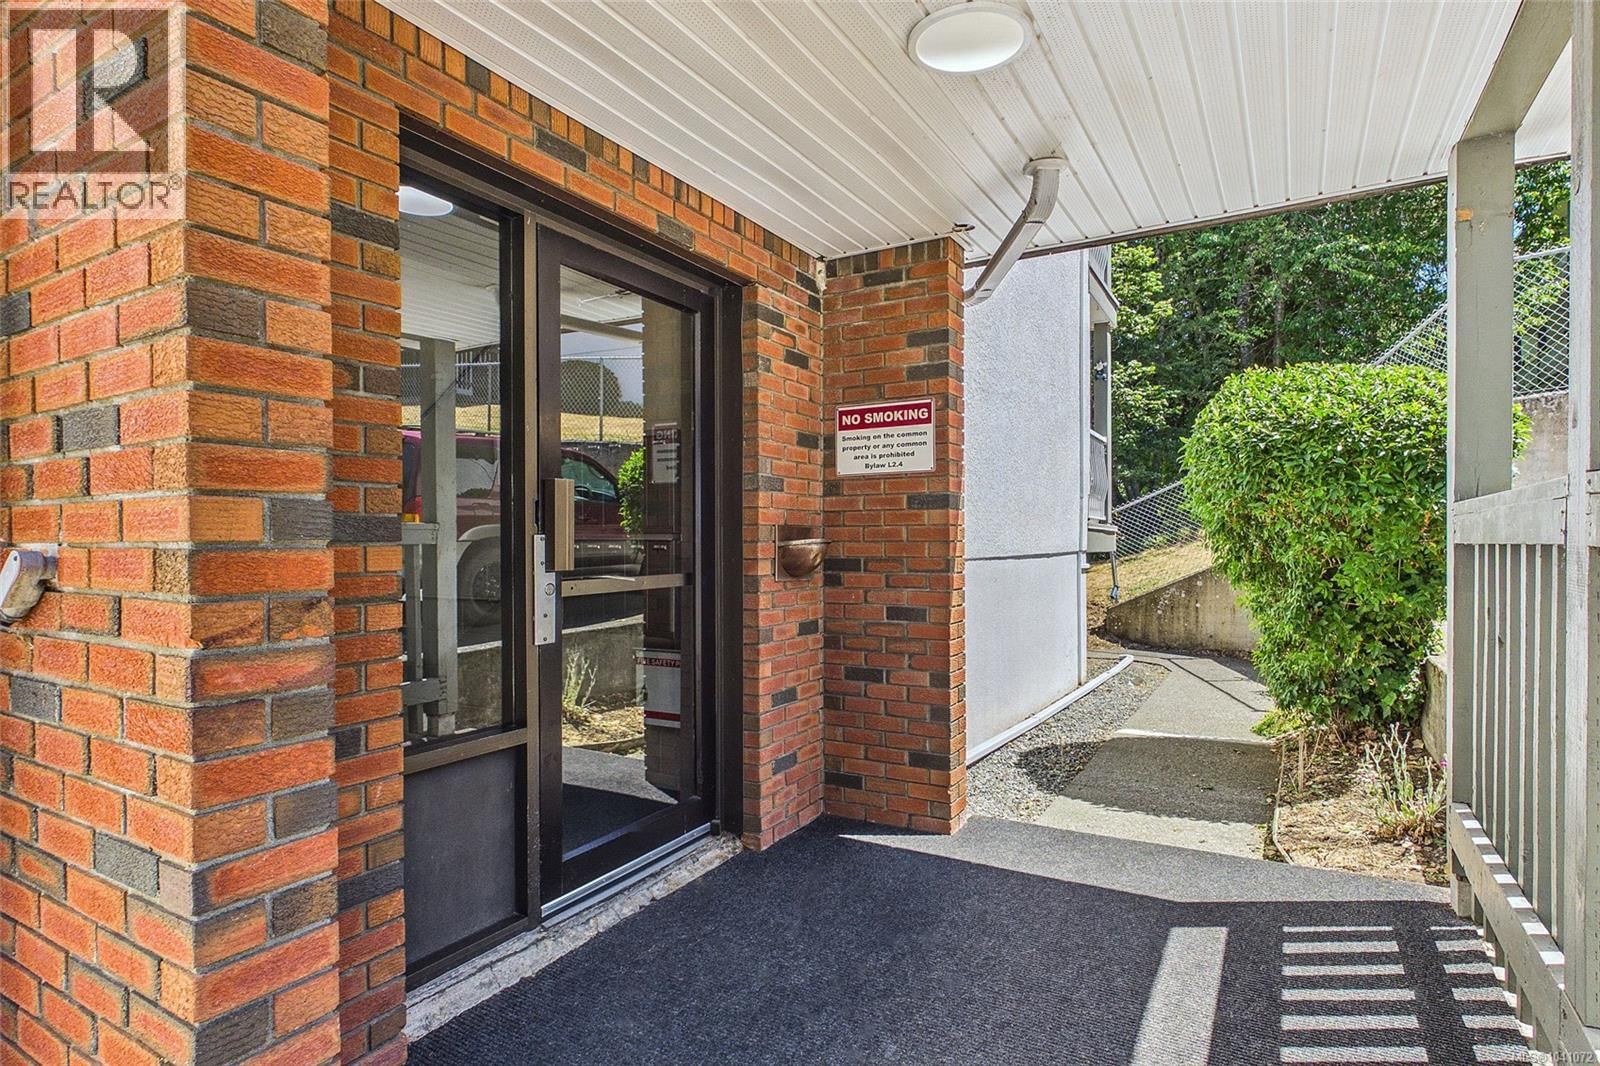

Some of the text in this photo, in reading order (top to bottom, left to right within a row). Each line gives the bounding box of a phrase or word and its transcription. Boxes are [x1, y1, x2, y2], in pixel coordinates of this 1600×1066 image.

[842, 408, 929, 426] NO SMOKING
[842, 434, 871, 442] Smoking
[896, 430, 928, 438] common
[842, 444, 871, 452] property
[896, 440, 928, 448] common
[878, 451, 915, 459] prohibited
[651, 658, 675, 667] SAFETY
